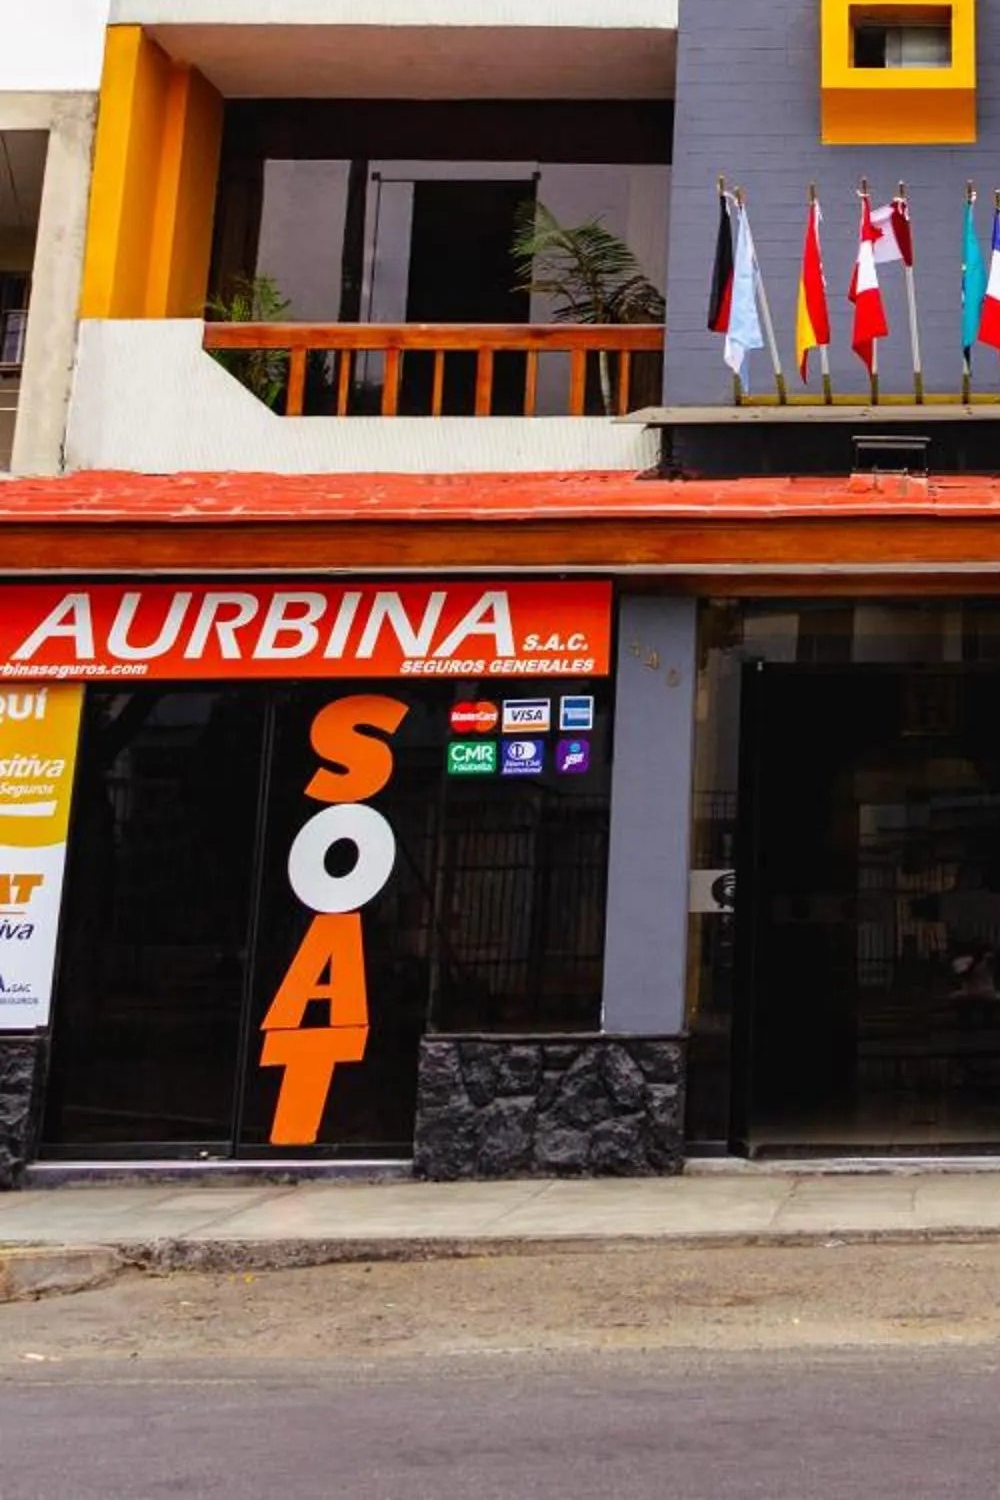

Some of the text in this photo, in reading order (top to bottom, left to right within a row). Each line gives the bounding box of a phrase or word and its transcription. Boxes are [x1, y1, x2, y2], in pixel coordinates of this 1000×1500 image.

[10, 590, 589, 660] AURBINA S.A.C.
[400, 658, 594, 673] SEGUROS GENERALES
[511, 709, 543, 722] VISA
[451, 745, 493, 762] CMR
[259, 694, 409, 1146] SOAT
